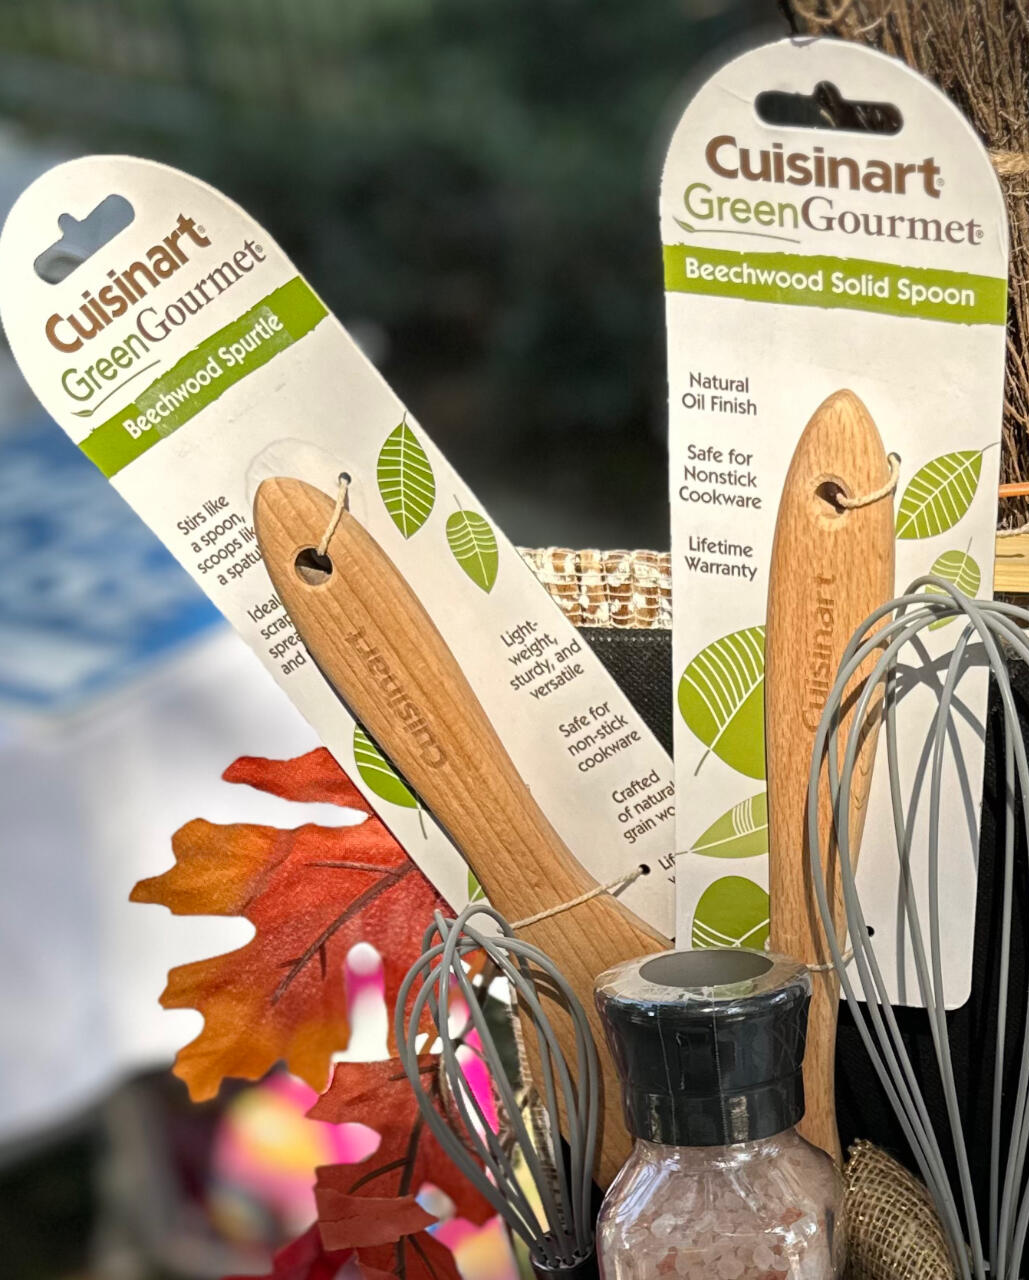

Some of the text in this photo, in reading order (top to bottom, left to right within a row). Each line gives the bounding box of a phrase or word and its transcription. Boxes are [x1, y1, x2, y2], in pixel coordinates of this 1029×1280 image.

[685, 257, 975, 306] Beechwood Solid Spoon
[123, 312, 283, 440] Beechwood Spurtle
[689, 372, 749, 393] Natural
[682, 393, 757, 415] Oil Finish
[687, 444, 753, 466] Safe for
[684, 465, 757, 488] Nonstick
[679, 486, 762, 509] Cookware
[177, 496, 229, 535] Stirs like
[191, 512, 246, 553] a spoon,
[197, 526, 256, 574] scoops lik
[689, 536, 753, 557] Lifetime
[217, 545, 262, 586] a spatul
[684, 556, 757, 581] Warranty
[260, 614, 292, 640] scrap
[500, 621, 538, 648] Light-
[269, 632, 303, 659] sprea
[281, 651, 307, 675] and
[508, 633, 558, 667] weight,
[510, 638, 582, 691] sturdy, and
[529, 661, 584, 700] versatile
[559, 701, 611, 738] Safe for
[567, 713, 628, 757] non-stick
[578, 729, 642, 773] cookware
[612, 769, 660, 805] Crafted
[617, 806, 633, 824] of
[623, 805, 676, 844] grain wo
